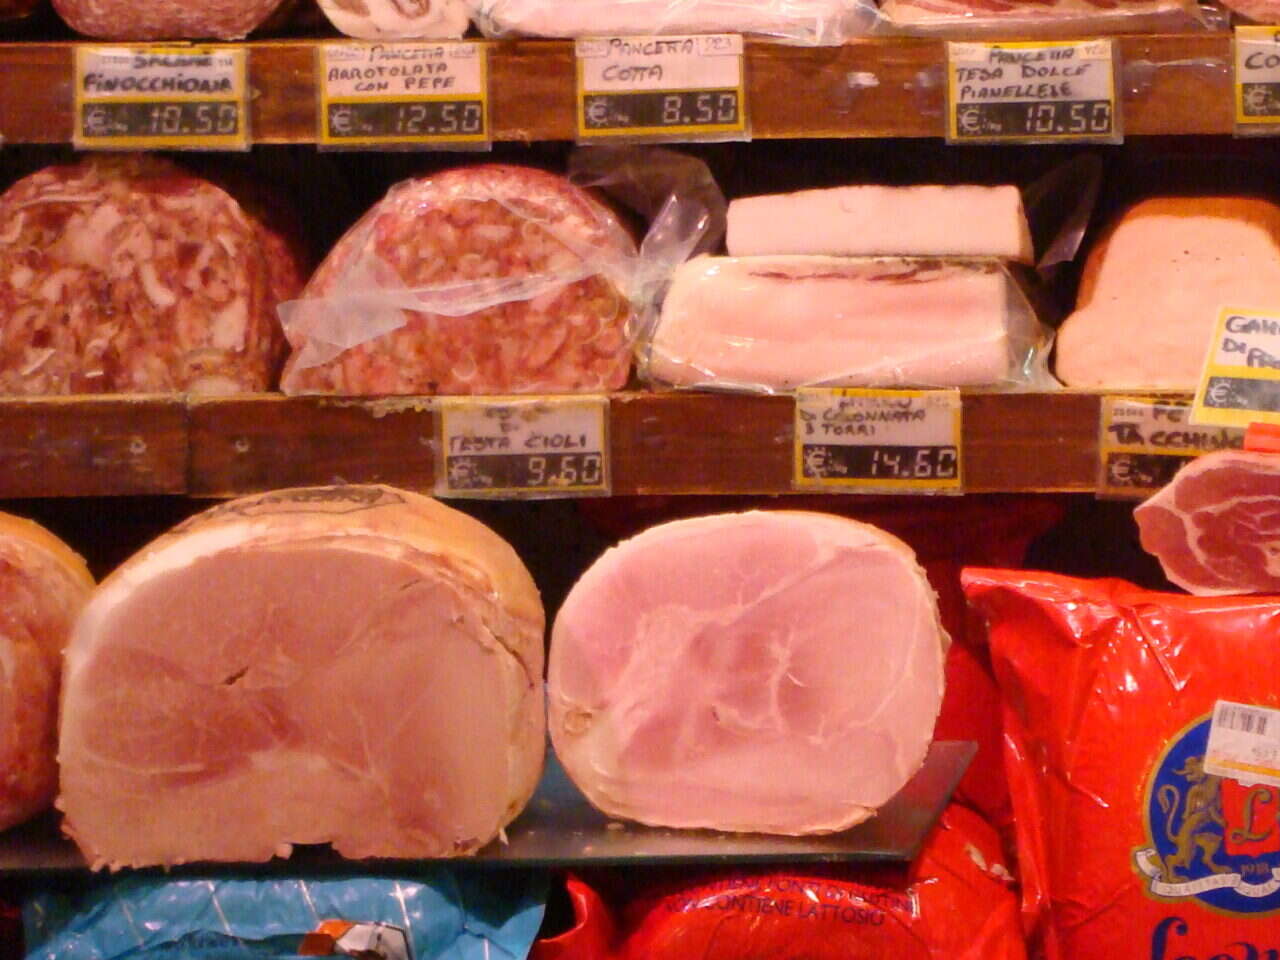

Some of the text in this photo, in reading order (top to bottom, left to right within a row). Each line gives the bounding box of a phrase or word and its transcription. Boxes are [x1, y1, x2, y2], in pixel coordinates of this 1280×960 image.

[607, 38, 693, 56] PANCETTA
[328, 63, 448, 81] ARROTOLATA
[355, 77, 456, 91] CON PEPE
[602, 64, 663, 81] COTTA
[956, 64, 1090, 83] TESA DOLCE
[151, 105, 236, 134] 10.50
[397, 105, 480, 134] 12.50
[663, 94, 736, 123] 8.50
[1026, 104, 1110, 133] 10.50
[822, 423, 876, 436] TORRI
[528, 457, 601, 486] 9.60
[872, 449, 956, 478] 14.60
